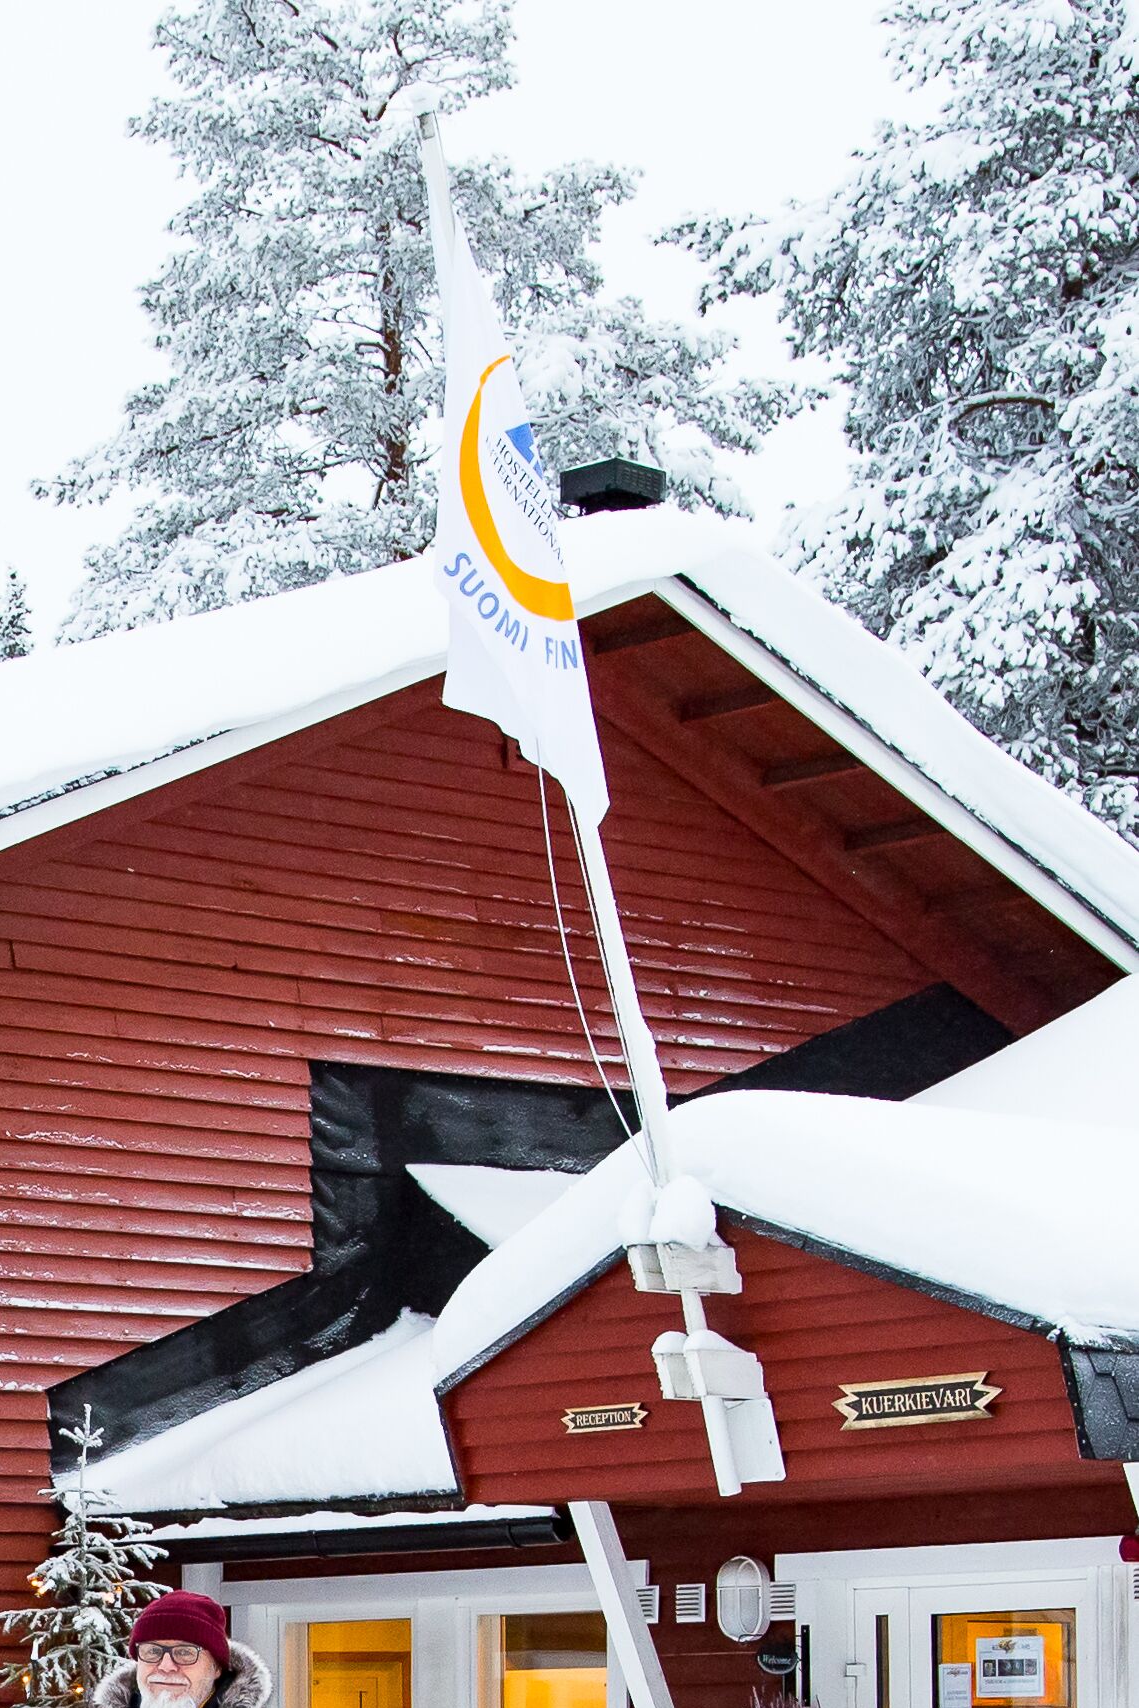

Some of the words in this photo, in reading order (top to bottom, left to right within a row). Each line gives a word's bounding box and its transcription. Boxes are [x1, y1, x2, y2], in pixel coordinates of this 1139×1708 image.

[443, 552, 529, 653] SUOMI
[545, 636, 579, 670] FIN
[862, 1387, 972, 1415] KUERKIEVARI
[576, 1410, 631, 1427] RECEPTION
